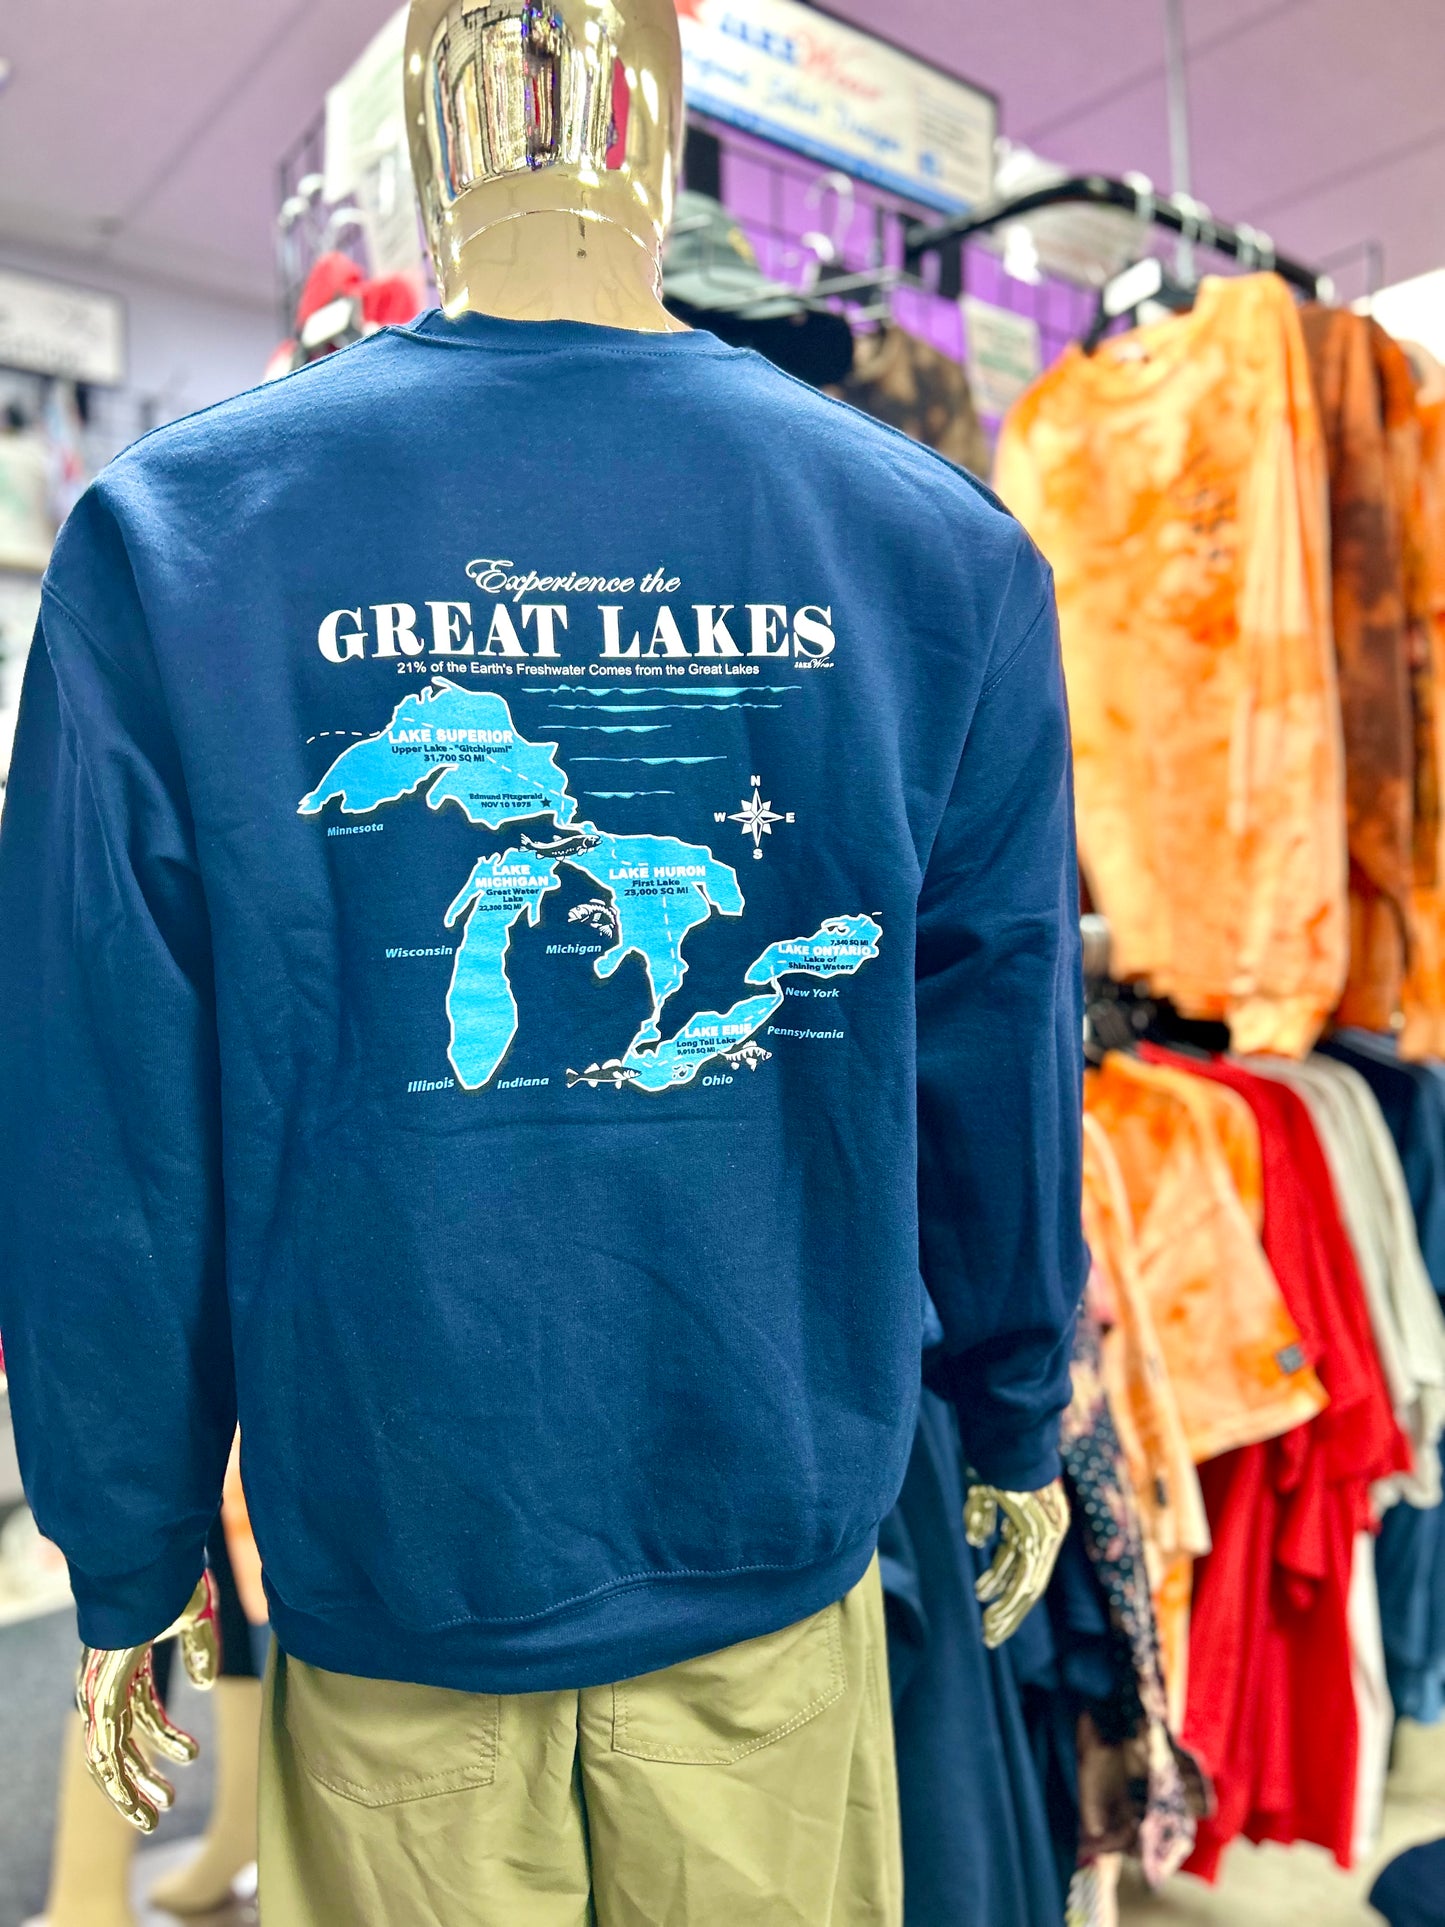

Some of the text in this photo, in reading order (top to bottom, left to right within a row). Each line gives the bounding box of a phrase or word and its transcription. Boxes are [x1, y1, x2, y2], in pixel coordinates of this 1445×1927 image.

[465, 558, 681, 602] Experience the
[318, 601, 836, 663] GREAT LAKES
[397, 661, 760, 676] 21% of the Earth's Freshwater Comes from the Great Lakes
[388, 729, 514, 744] LAKE SUPERIOR
[392, 745, 422, 755] Upper
[424, 744, 448, 753] Lake
[424, 754, 485, 763] 31,700 SQ MI
[750, 775, 760, 787] N
[713, 812, 726, 823] W
[785, 812, 796, 823] E
[327, 822, 384, 837] Minnesota
[752, 848, 763, 859] S
[492, 864, 531, 876] LAKE
[609, 865, 706, 880] LAKE HURON
[475, 876, 549, 888] MICHIGAN
[656, 879, 680, 887] Lake
[486, 888, 511, 896] Great
[624, 886, 688, 897] 23,000 SQ MI
[479, 904, 502, 912] 22,300
[385, 945, 453, 958] Wisconsin
[546, 944, 602, 956] Michigan
[778, 943, 871, 956] LAKE ONTARIO
[788, 961, 821, 971] Shining
[785, 987, 840, 998] New York
[685, 1023, 752, 1038] LAKE ERIE
[767, 1025, 844, 1039] Pennsylvania
[676, 1040, 698, 1048] Long
[407, 1076, 455, 1093] Illinois
[497, 1077, 549, 1090] Indiana
[702, 1074, 733, 1086] Ohio
